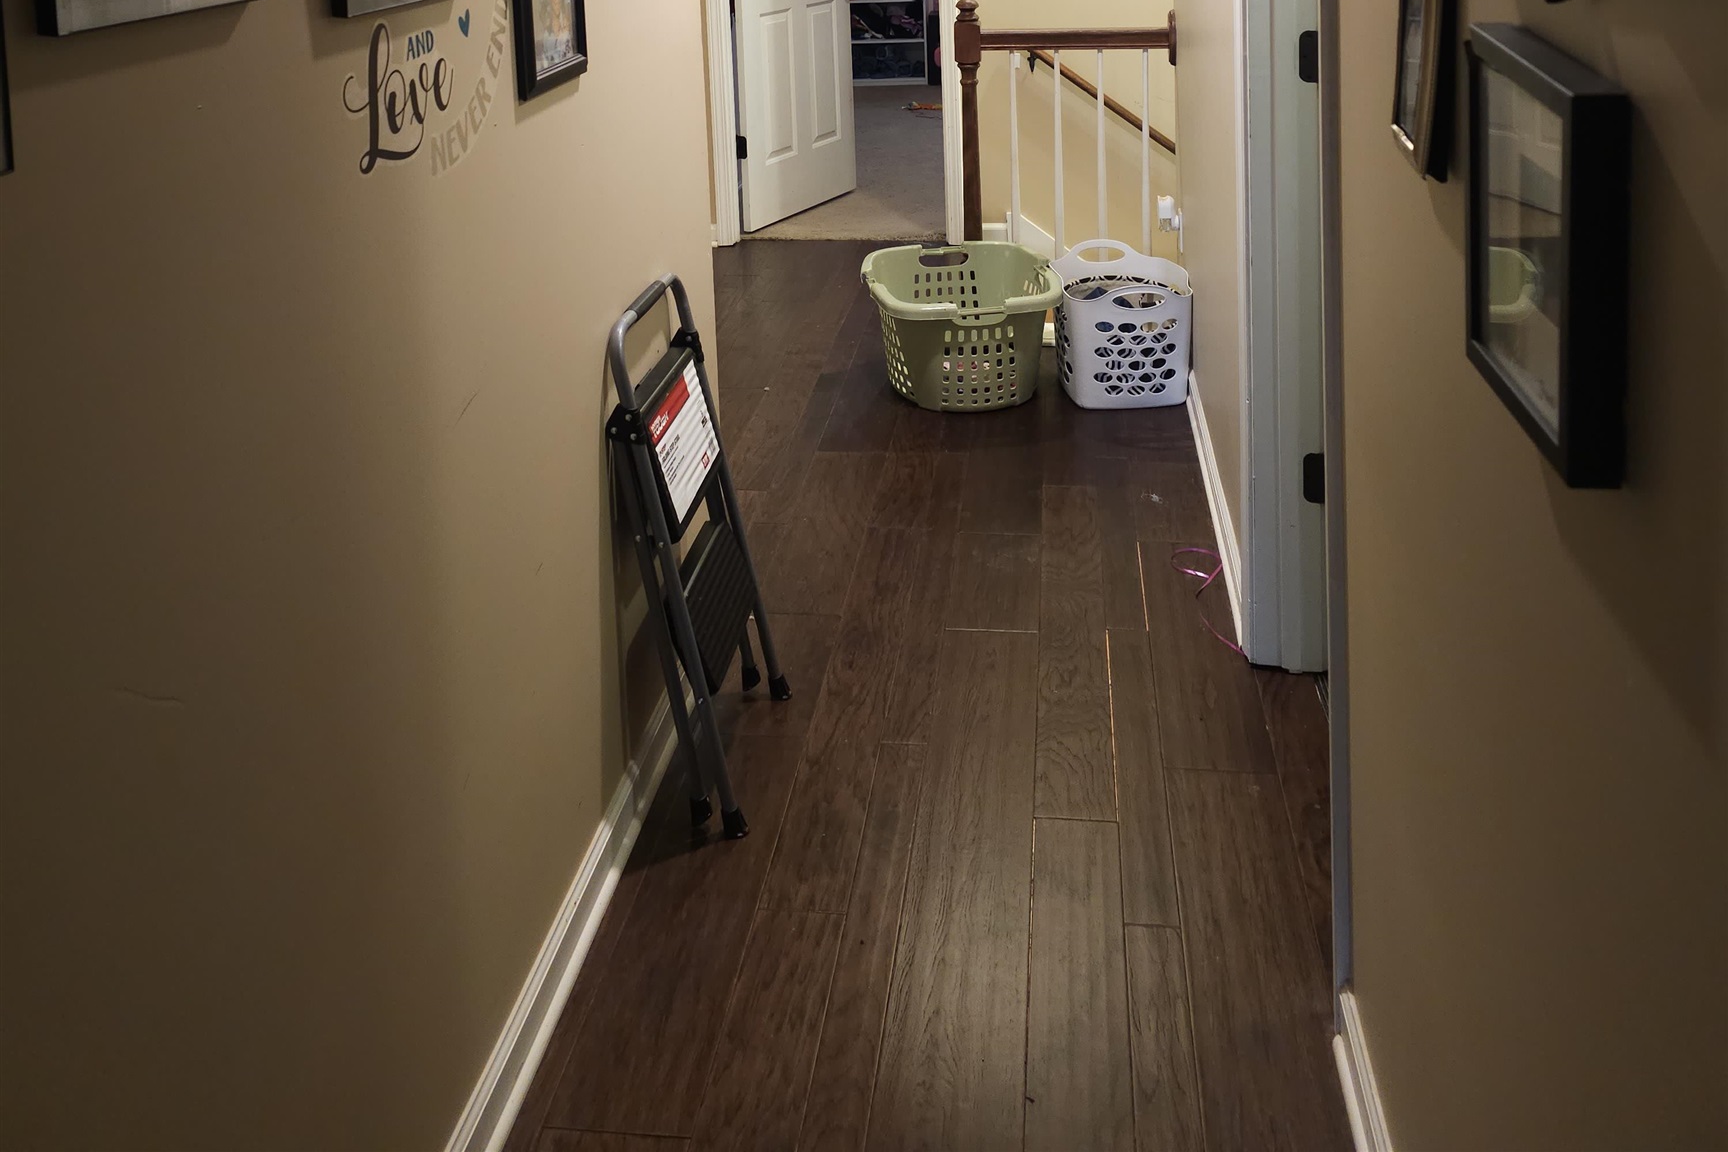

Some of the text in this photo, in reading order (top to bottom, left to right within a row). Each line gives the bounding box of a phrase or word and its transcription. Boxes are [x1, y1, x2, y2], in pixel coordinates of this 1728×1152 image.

[406, 30, 434, 62] AND
[343, 23, 454, 175] Love
[430, 77, 492, 176] NEVER
